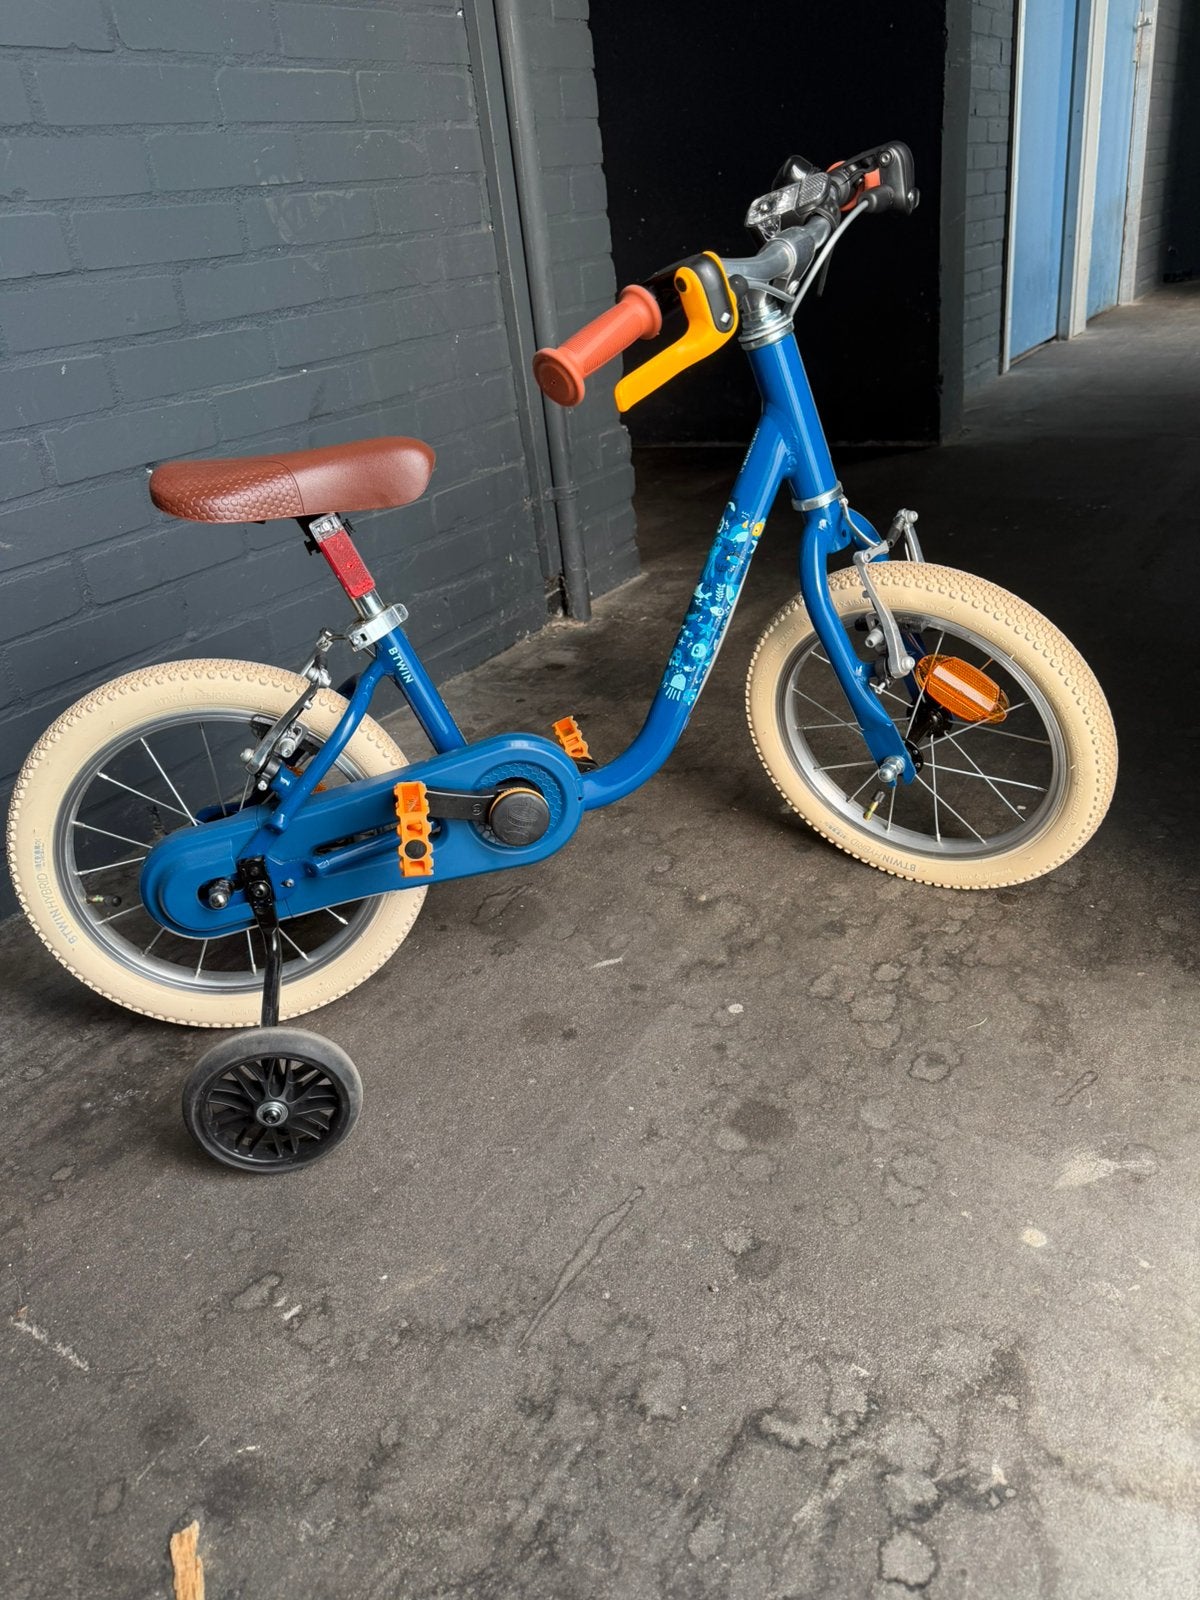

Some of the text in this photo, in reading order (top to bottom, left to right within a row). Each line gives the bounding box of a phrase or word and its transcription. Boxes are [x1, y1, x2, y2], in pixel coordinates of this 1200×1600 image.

[388, 646, 414, 684] BTWIN
[882, 854, 917, 872] BTWIN
[49, 908, 77, 945] BTWIN
